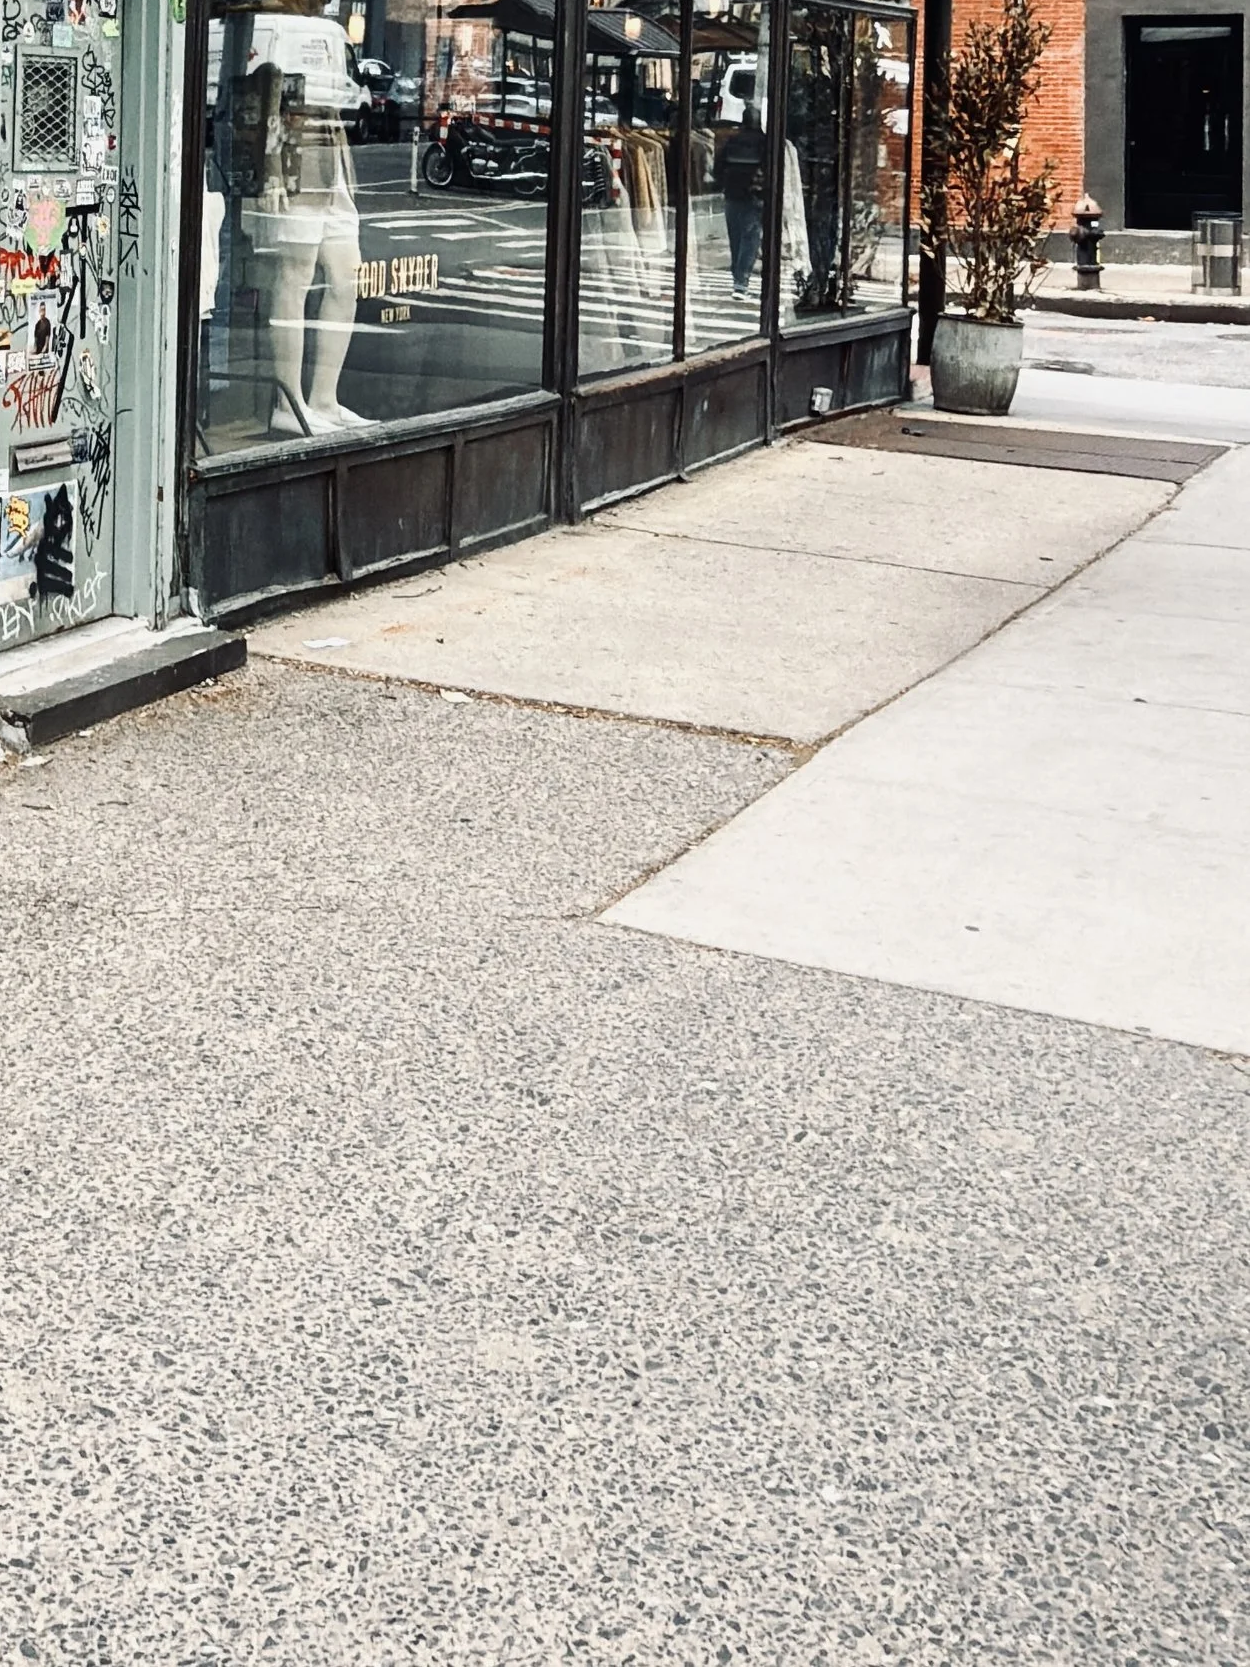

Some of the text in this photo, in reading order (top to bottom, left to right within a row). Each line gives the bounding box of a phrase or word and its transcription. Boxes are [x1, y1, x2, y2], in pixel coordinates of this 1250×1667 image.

[353, 253, 439, 299] TODD SNYDER
[380, 305, 411, 324] NEW YORK
